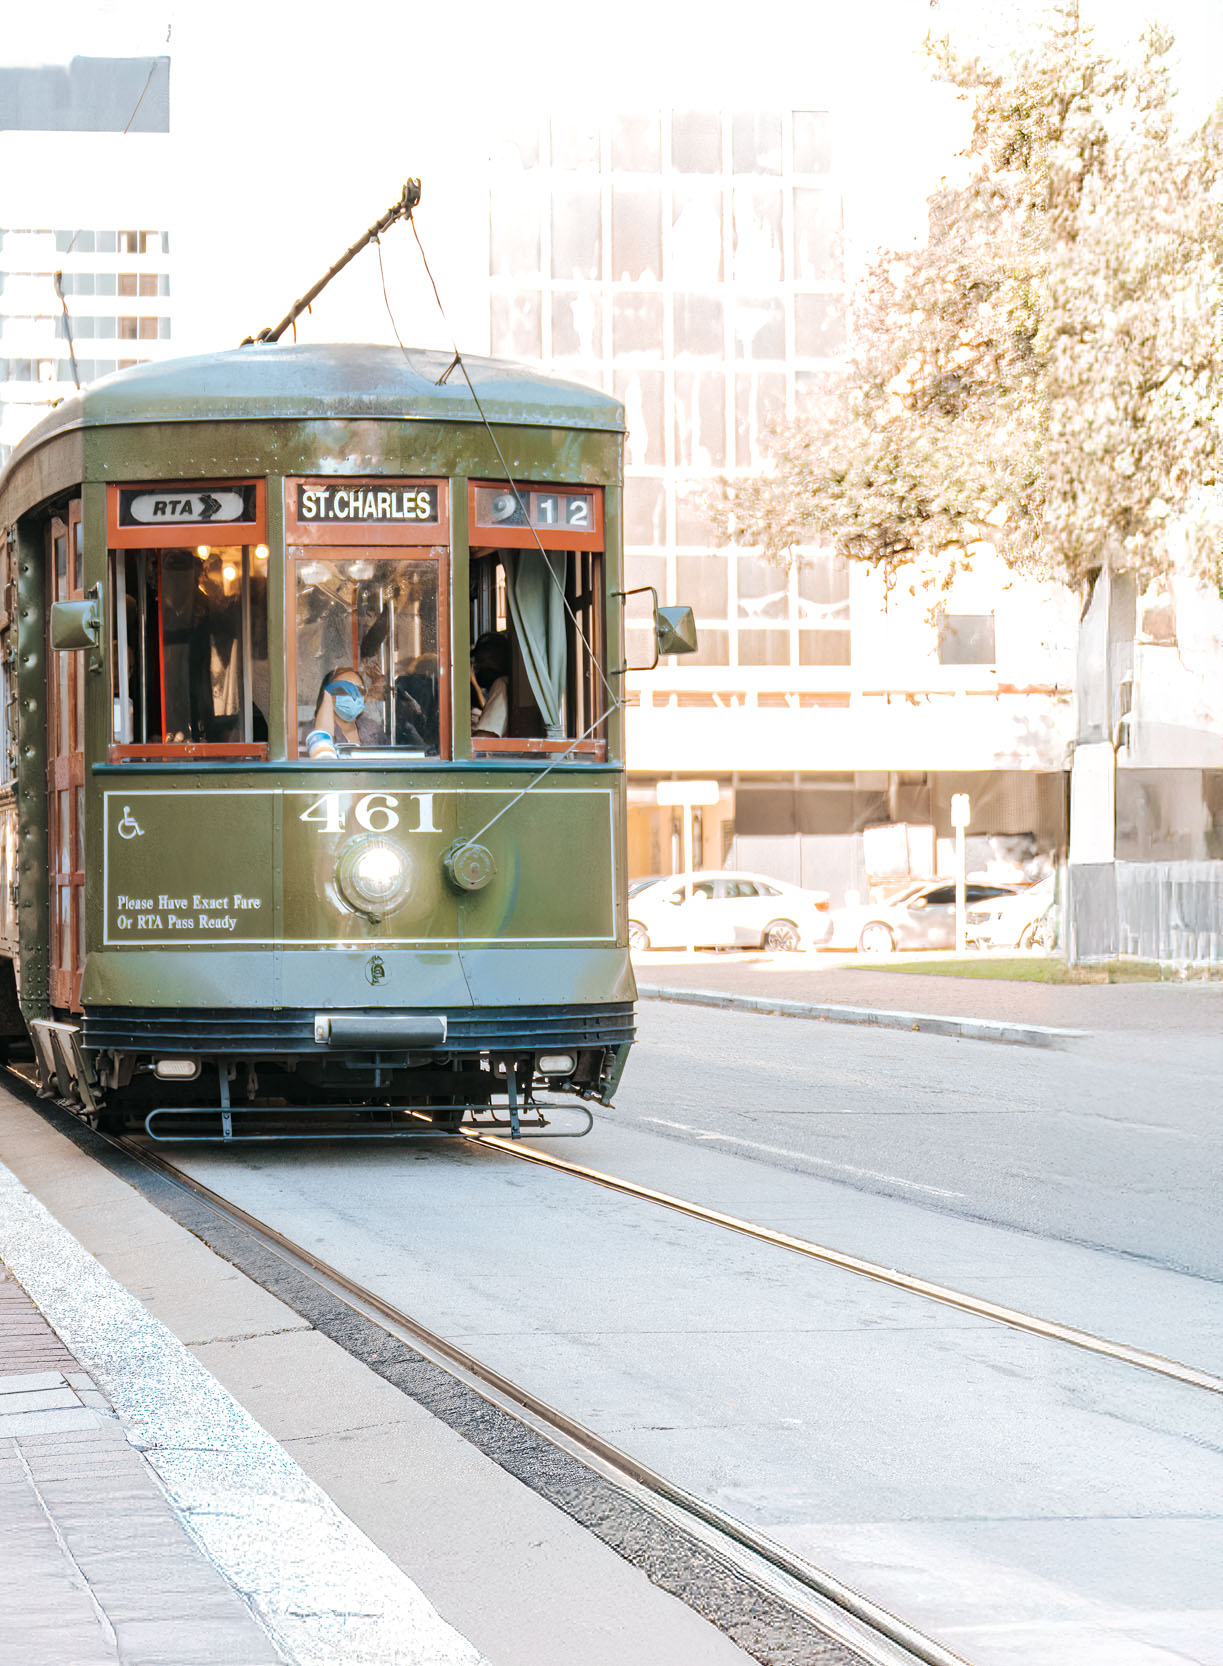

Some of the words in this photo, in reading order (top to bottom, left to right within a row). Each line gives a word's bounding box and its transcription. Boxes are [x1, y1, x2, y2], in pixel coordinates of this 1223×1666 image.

[152, 499, 194, 516] RTA
[298, 792, 443, 833] 461
[117, 895, 154, 910] Please
[158, 894, 188, 910] Have
[192, 894, 229, 910] Exact
[233, 893, 262, 910] Fare
[117, 914, 133, 930] Or
[137, 914, 164, 929] RTA
[167, 914, 195, 929] Pass
[198, 914, 239, 931] Ready
